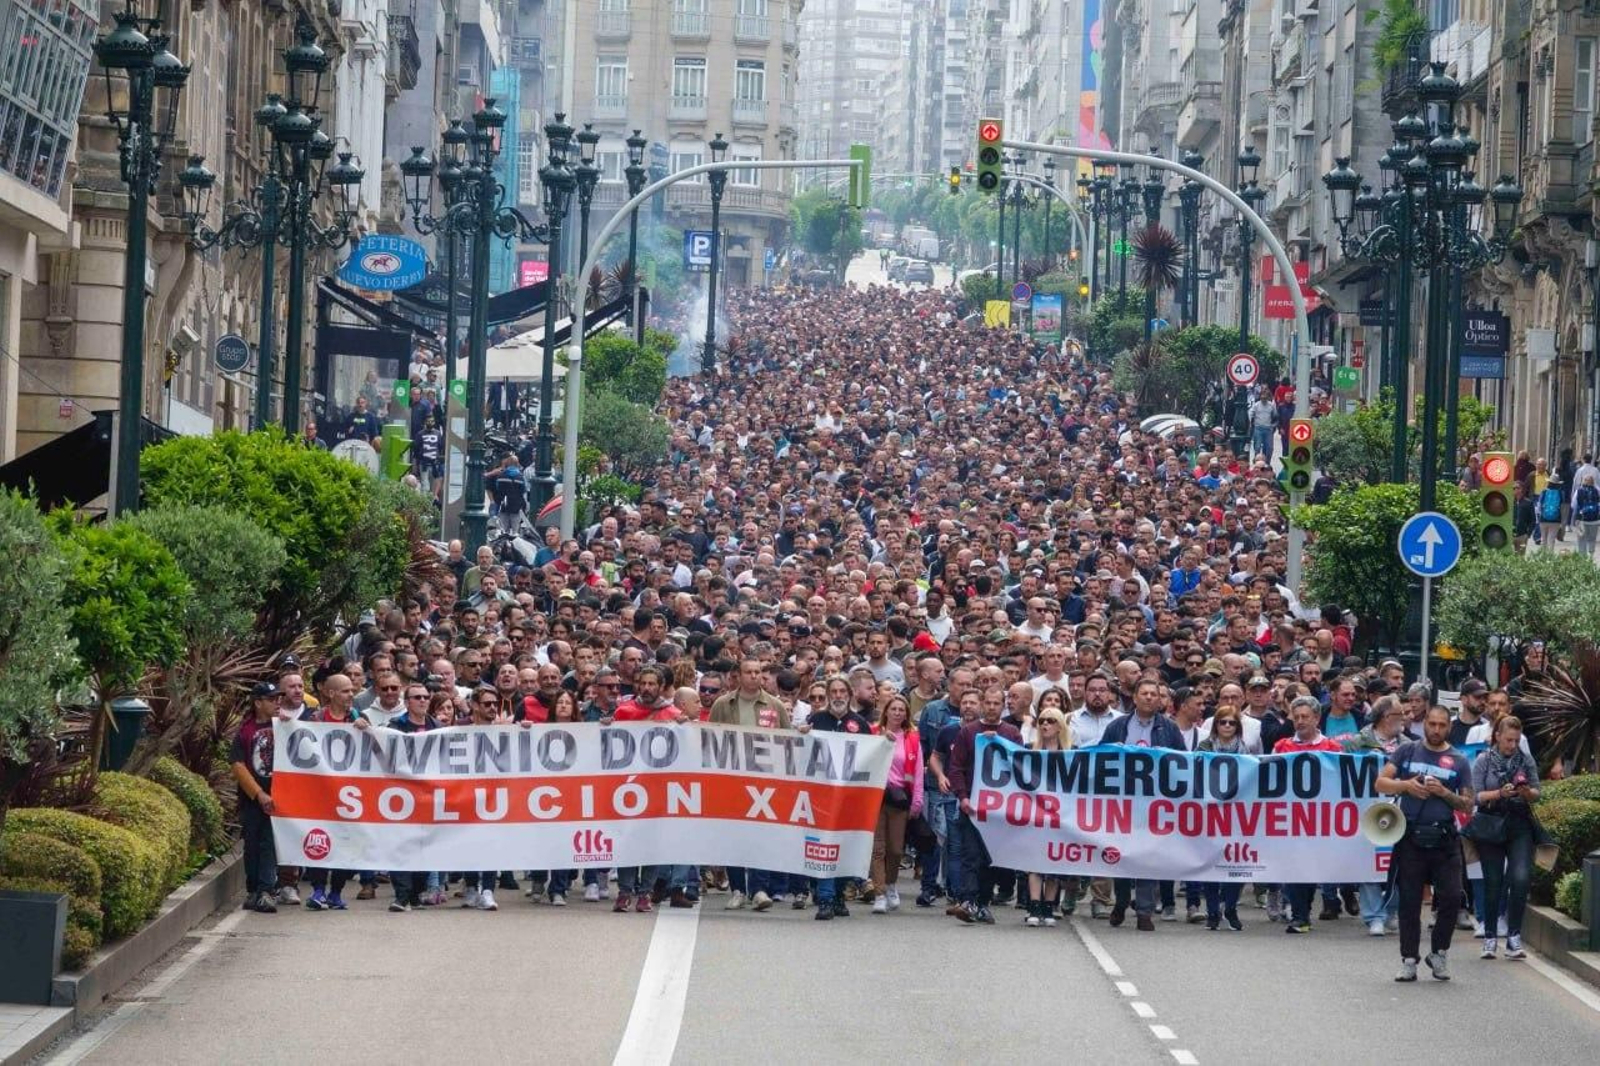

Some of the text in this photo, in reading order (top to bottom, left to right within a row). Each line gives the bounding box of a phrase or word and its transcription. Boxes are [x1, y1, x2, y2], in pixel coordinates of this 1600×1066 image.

[357, 237, 424, 261] FETERIA
[694, 236, 710, 255] P
[384, 270, 424, 288] DERBY
[1469, 320, 1496, 330] Ulloa
[1234, 364, 1252, 375] 40
[286, 726, 870, 781] CONVENIO DO METAL
[981, 742, 1394, 800] COMERCIO DO M
[336, 776, 816, 825] SOLUCIÓN XA
[976, 789, 1358, 837] POR UN CONVENIO
[573, 829, 613, 854] CIG
[806, 844, 838, 859] CCOO
[1047, 841, 1097, 863] UGT
[1224, 842, 1258, 863] CIG
